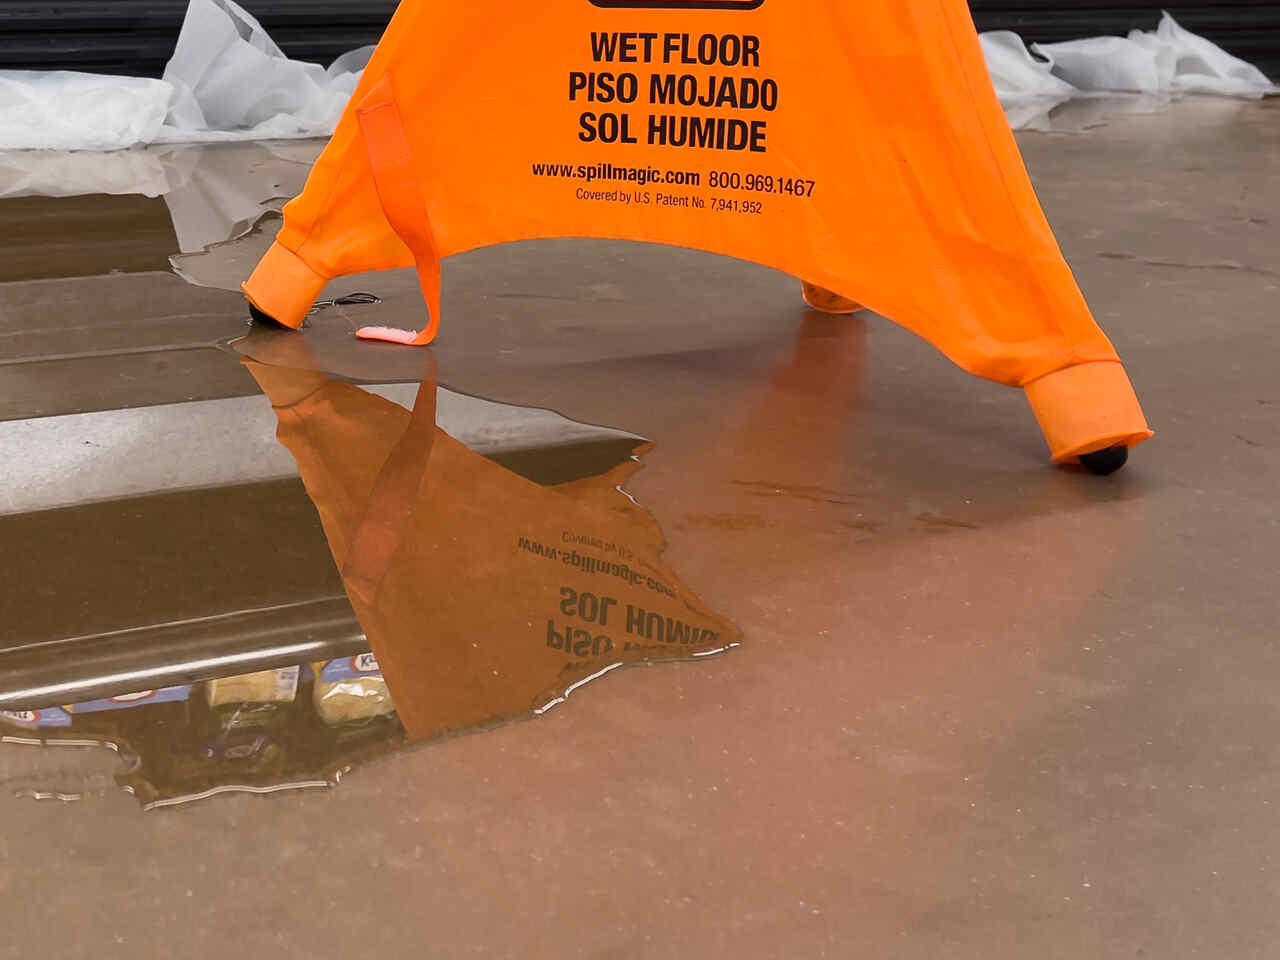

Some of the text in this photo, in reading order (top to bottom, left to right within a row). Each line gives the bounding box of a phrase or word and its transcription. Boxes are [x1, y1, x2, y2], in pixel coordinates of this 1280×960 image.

[590, 31, 761, 68] WET FLOOR
[568, 71, 778, 112] PISO MOJADO
[578, 111, 767, 153] SOL HUMIDE
[532, 162, 816, 198] www.spillmagic.com 800.969.1467
[575, 187, 618, 202] Covered
[619, 190, 632, 204] by
[656, 193, 689, 209] Patent
